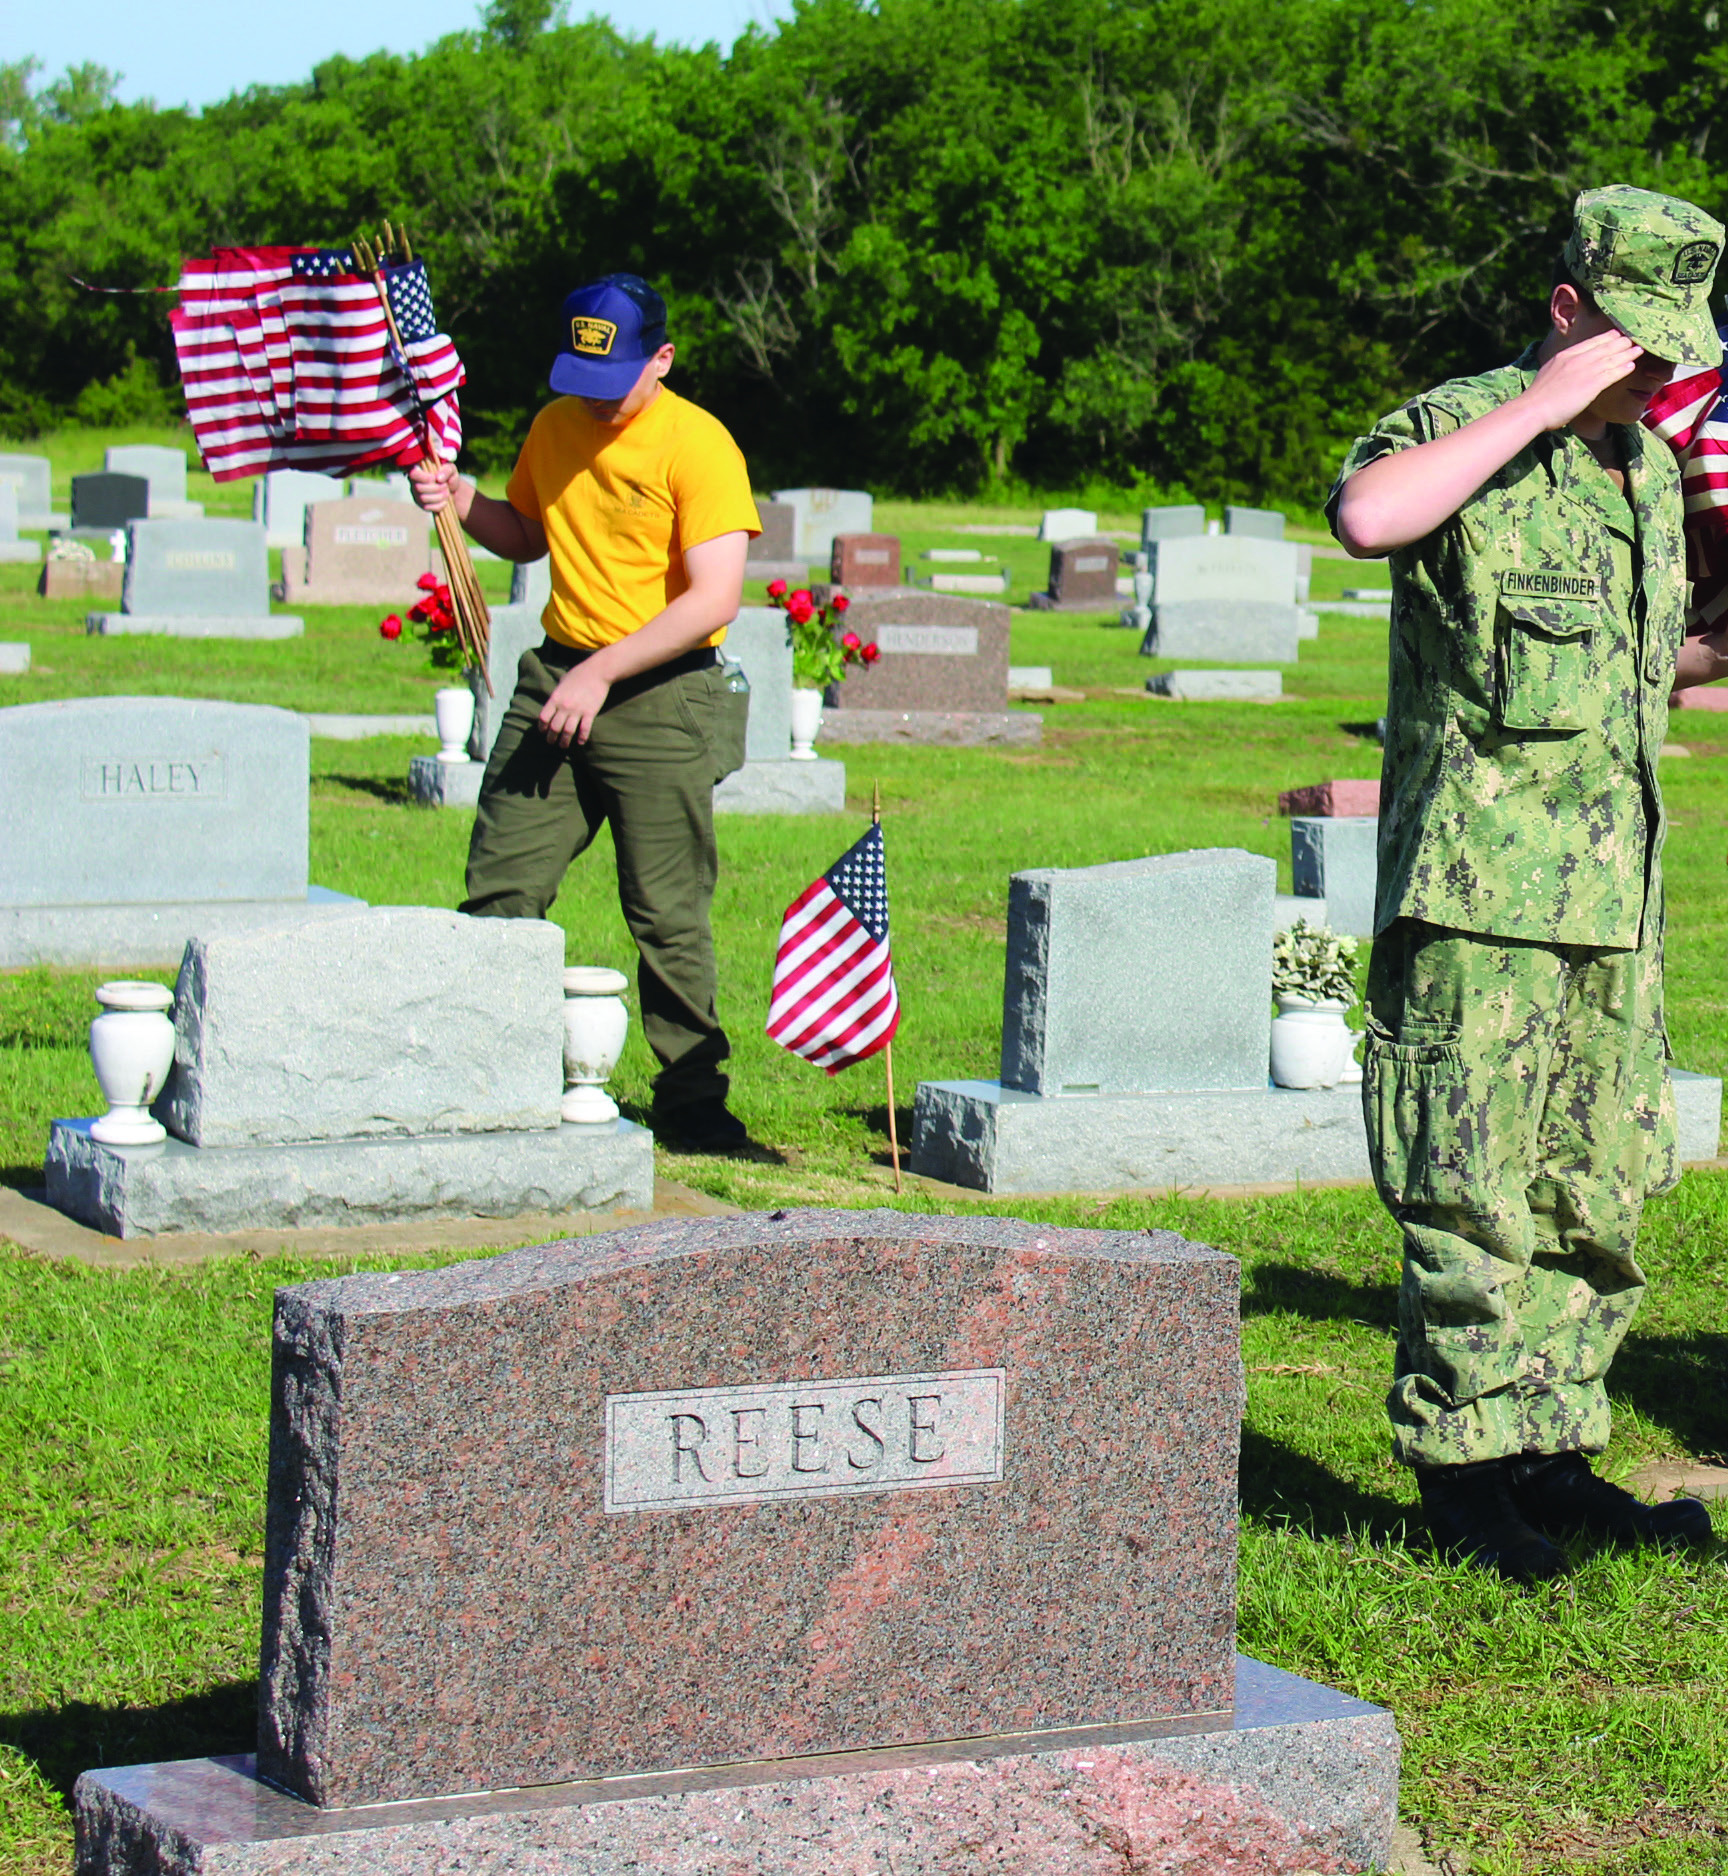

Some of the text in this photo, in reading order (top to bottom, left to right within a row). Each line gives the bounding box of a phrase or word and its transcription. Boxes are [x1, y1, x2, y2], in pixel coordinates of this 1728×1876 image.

[1507, 572, 1595, 596] FINKENBINDER
[101, 763, 207, 794] HALEY
[669, 1393, 946, 1484] REESE
